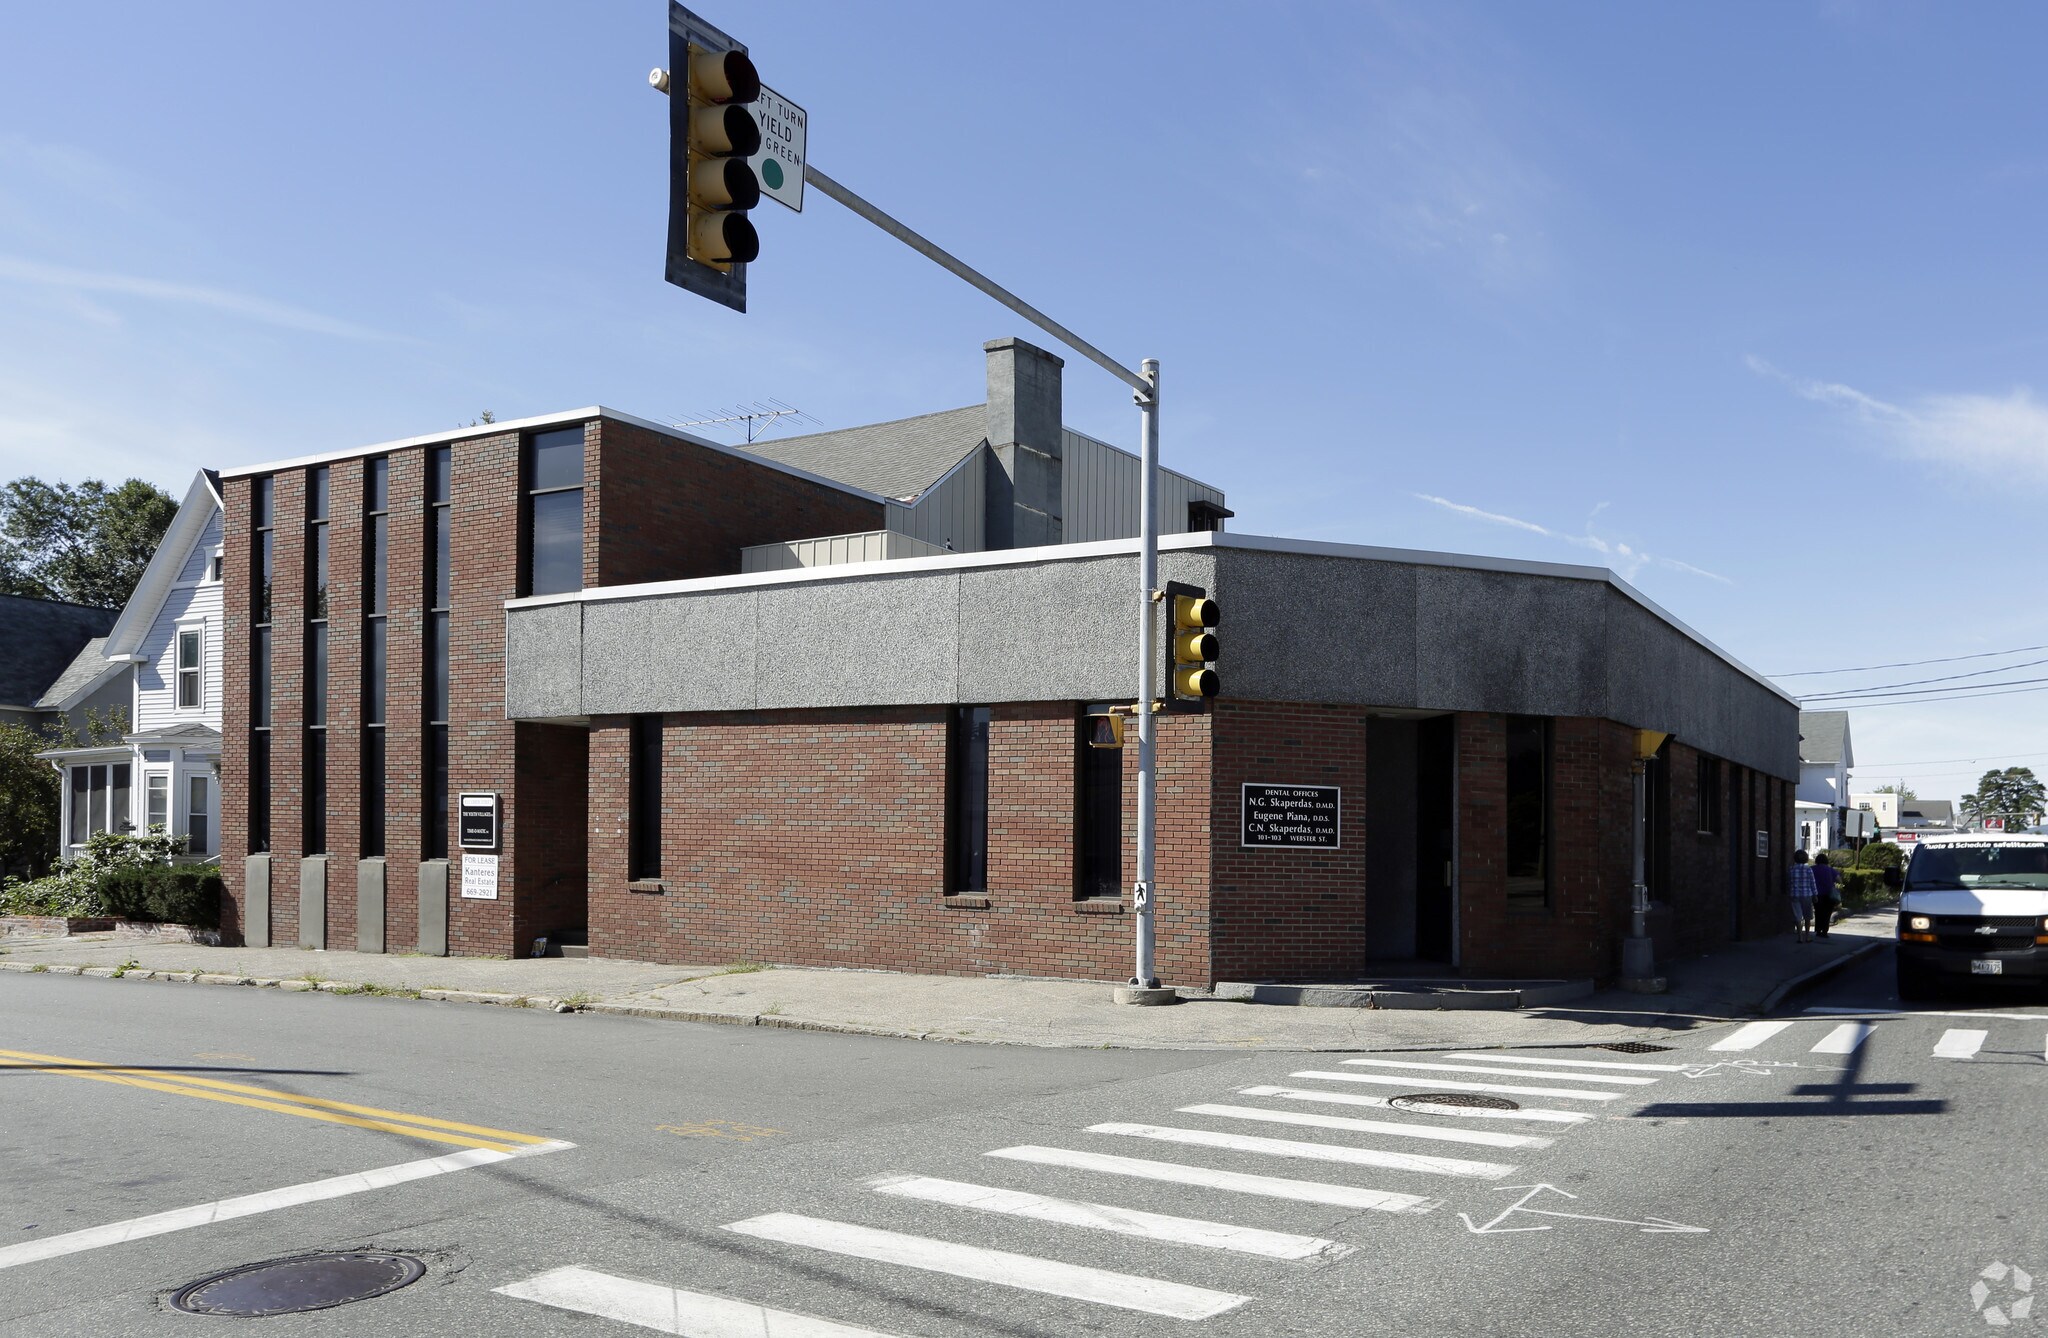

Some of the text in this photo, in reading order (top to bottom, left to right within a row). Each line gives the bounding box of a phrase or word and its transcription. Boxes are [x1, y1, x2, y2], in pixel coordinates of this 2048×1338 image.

[777, 103, 804, 129] TURN
[759, 109, 792, 143] YIELD
[766, 137, 800, 167] GREEN
[1249, 798, 1266, 806] N.G.
[1253, 811, 1284, 822] Eugene
[1286, 812, 1311, 823] Piana,
[1248, 823, 1266, 832] C.N.
[464, 867, 495, 877] Kanteres
[464, 877, 476, 885] Real
[466, 888, 492, 897] 669-2921
